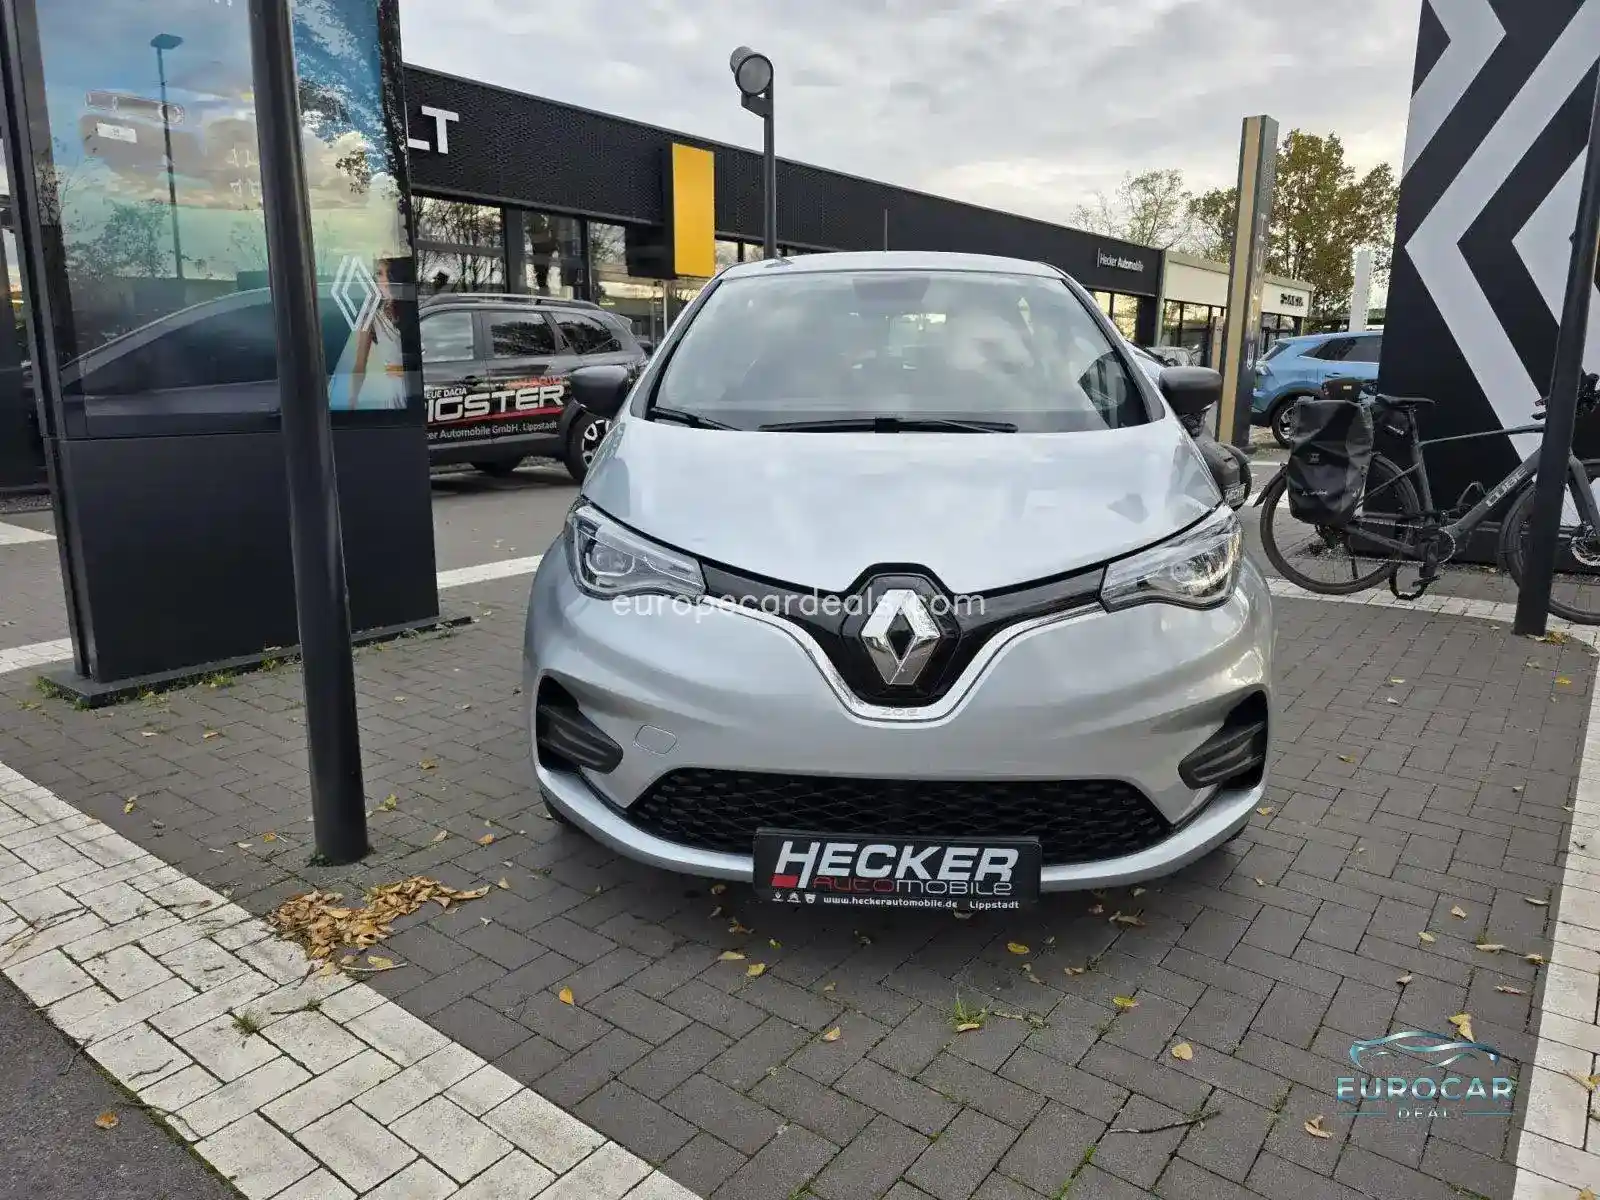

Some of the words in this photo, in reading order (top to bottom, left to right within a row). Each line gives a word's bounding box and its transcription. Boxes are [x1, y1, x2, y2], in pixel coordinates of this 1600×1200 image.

[443, 387, 467, 397] DACIA
[424, 384, 565, 422] IGSTER
[439, 424, 490, 438] Automobile
[522, 418, 557, 432] Lippstadt
[774, 840, 1019, 889] HECKER
[823, 896, 958, 909] www.heckerautomobile.de
[969, 900, 1020, 911] Lippstadt
